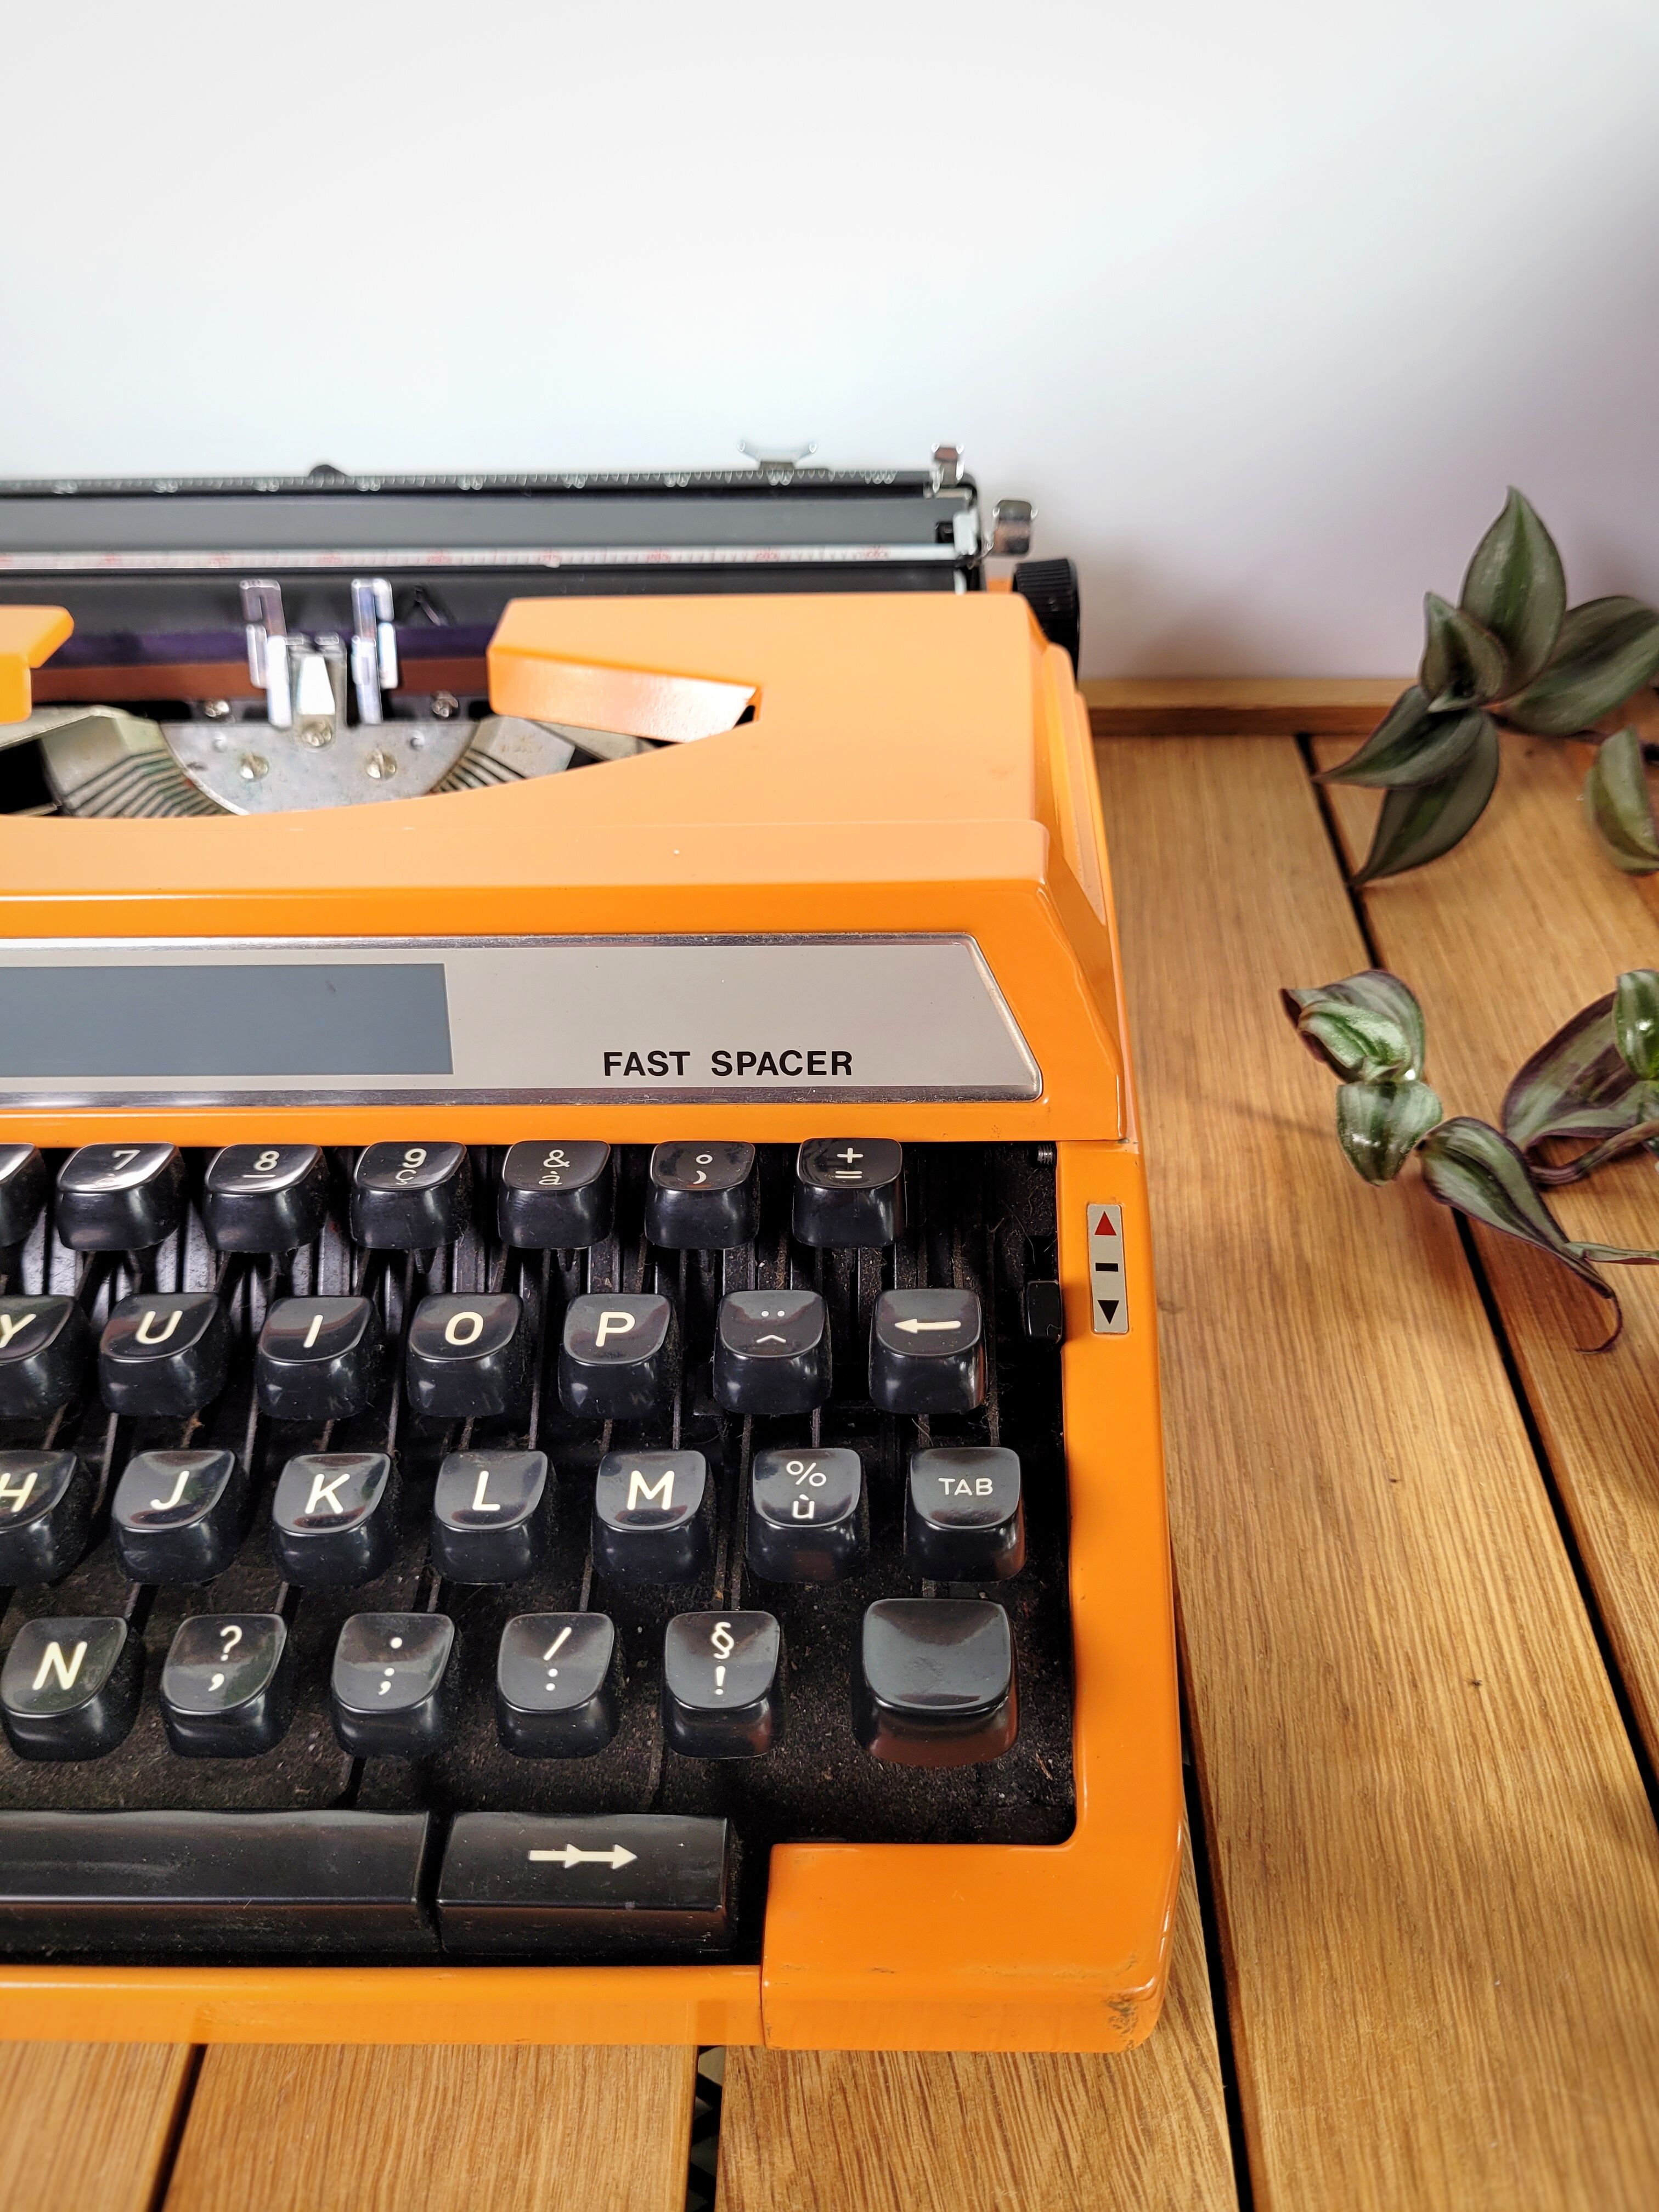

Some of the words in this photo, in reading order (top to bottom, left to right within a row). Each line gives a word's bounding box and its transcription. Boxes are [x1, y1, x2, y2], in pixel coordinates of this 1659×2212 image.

[603, 1050, 691, 1077] FAST
[711, 1049, 853, 1077] SPACER
[111, 1149, 141, 1171] 7
[255, 1150, 280, 1171] 8
[402, 1148, 427, 1168] 9
[543, 1149, 570, 1167] &
[837, 1147, 864, 1164] +
[538, 1171, 563, 1185] à
[834, 1171, 862, 1179] =
[0, 1313, 36, 1348] Y
[136, 1310, 183, 1344] U
[304, 1314, 324, 1348] I
[445, 1311, 483, 1345] O
[595, 1311, 635, 1347] P
[786, 1460, 827, 1487] %
[938, 1477, 993, 1496] TAB
[0, 1472, 38, 1513] H
[150, 1470, 190, 1510] J
[304, 1473, 351, 1514] K
[472, 1470, 501, 1511] L
[627, 1470, 675, 1510] M
[793, 1494, 815, 1519] ù
[220, 1625, 242, 1661] ?
[543, 1627, 572, 1661] /
[712, 1622, 734, 1660] §
[32, 1641, 88, 1690] N
[379, 1667, 395, 1695] ;
[546, 1668, 558, 1691] :
[715, 1666, 726, 1695] !
